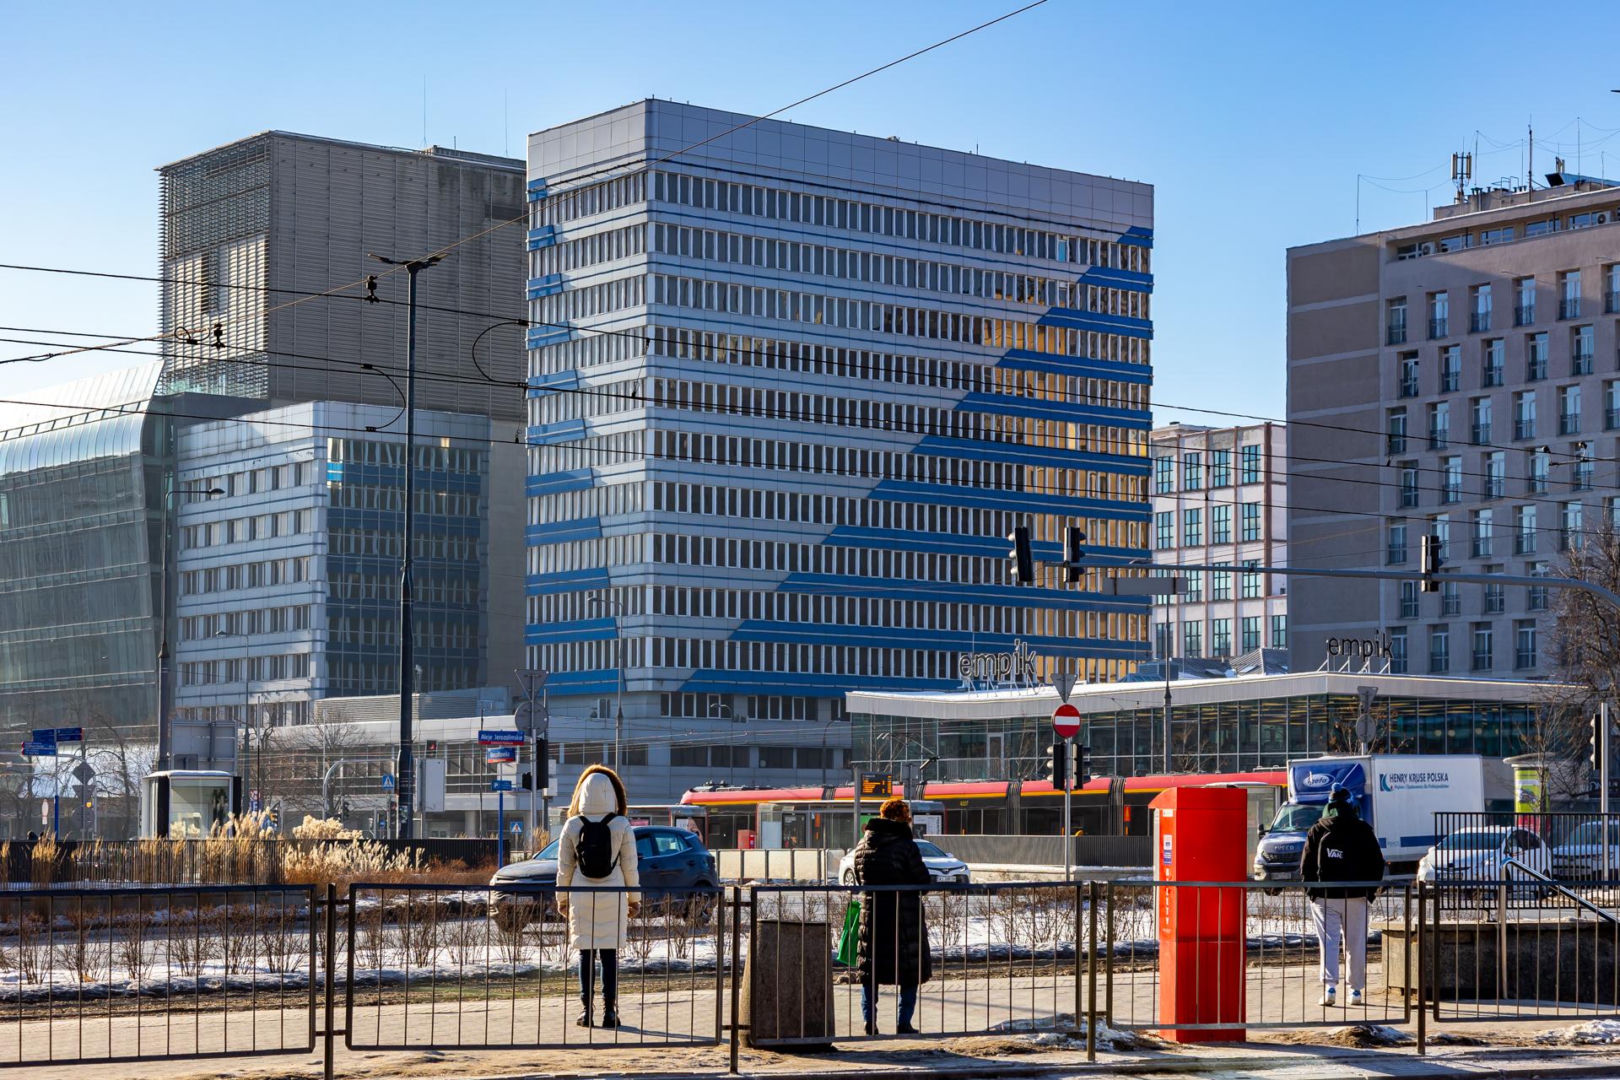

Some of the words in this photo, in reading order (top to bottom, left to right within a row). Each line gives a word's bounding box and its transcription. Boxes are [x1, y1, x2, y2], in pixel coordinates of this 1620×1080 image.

[959, 639, 1036, 682] empik
[1328, 629, 1393, 662] empik
[1389, 773, 1407, 783] HENRY
[1409, 773, 1426, 783] KRUSE
[1427, 772, 1449, 782] POLSKA
